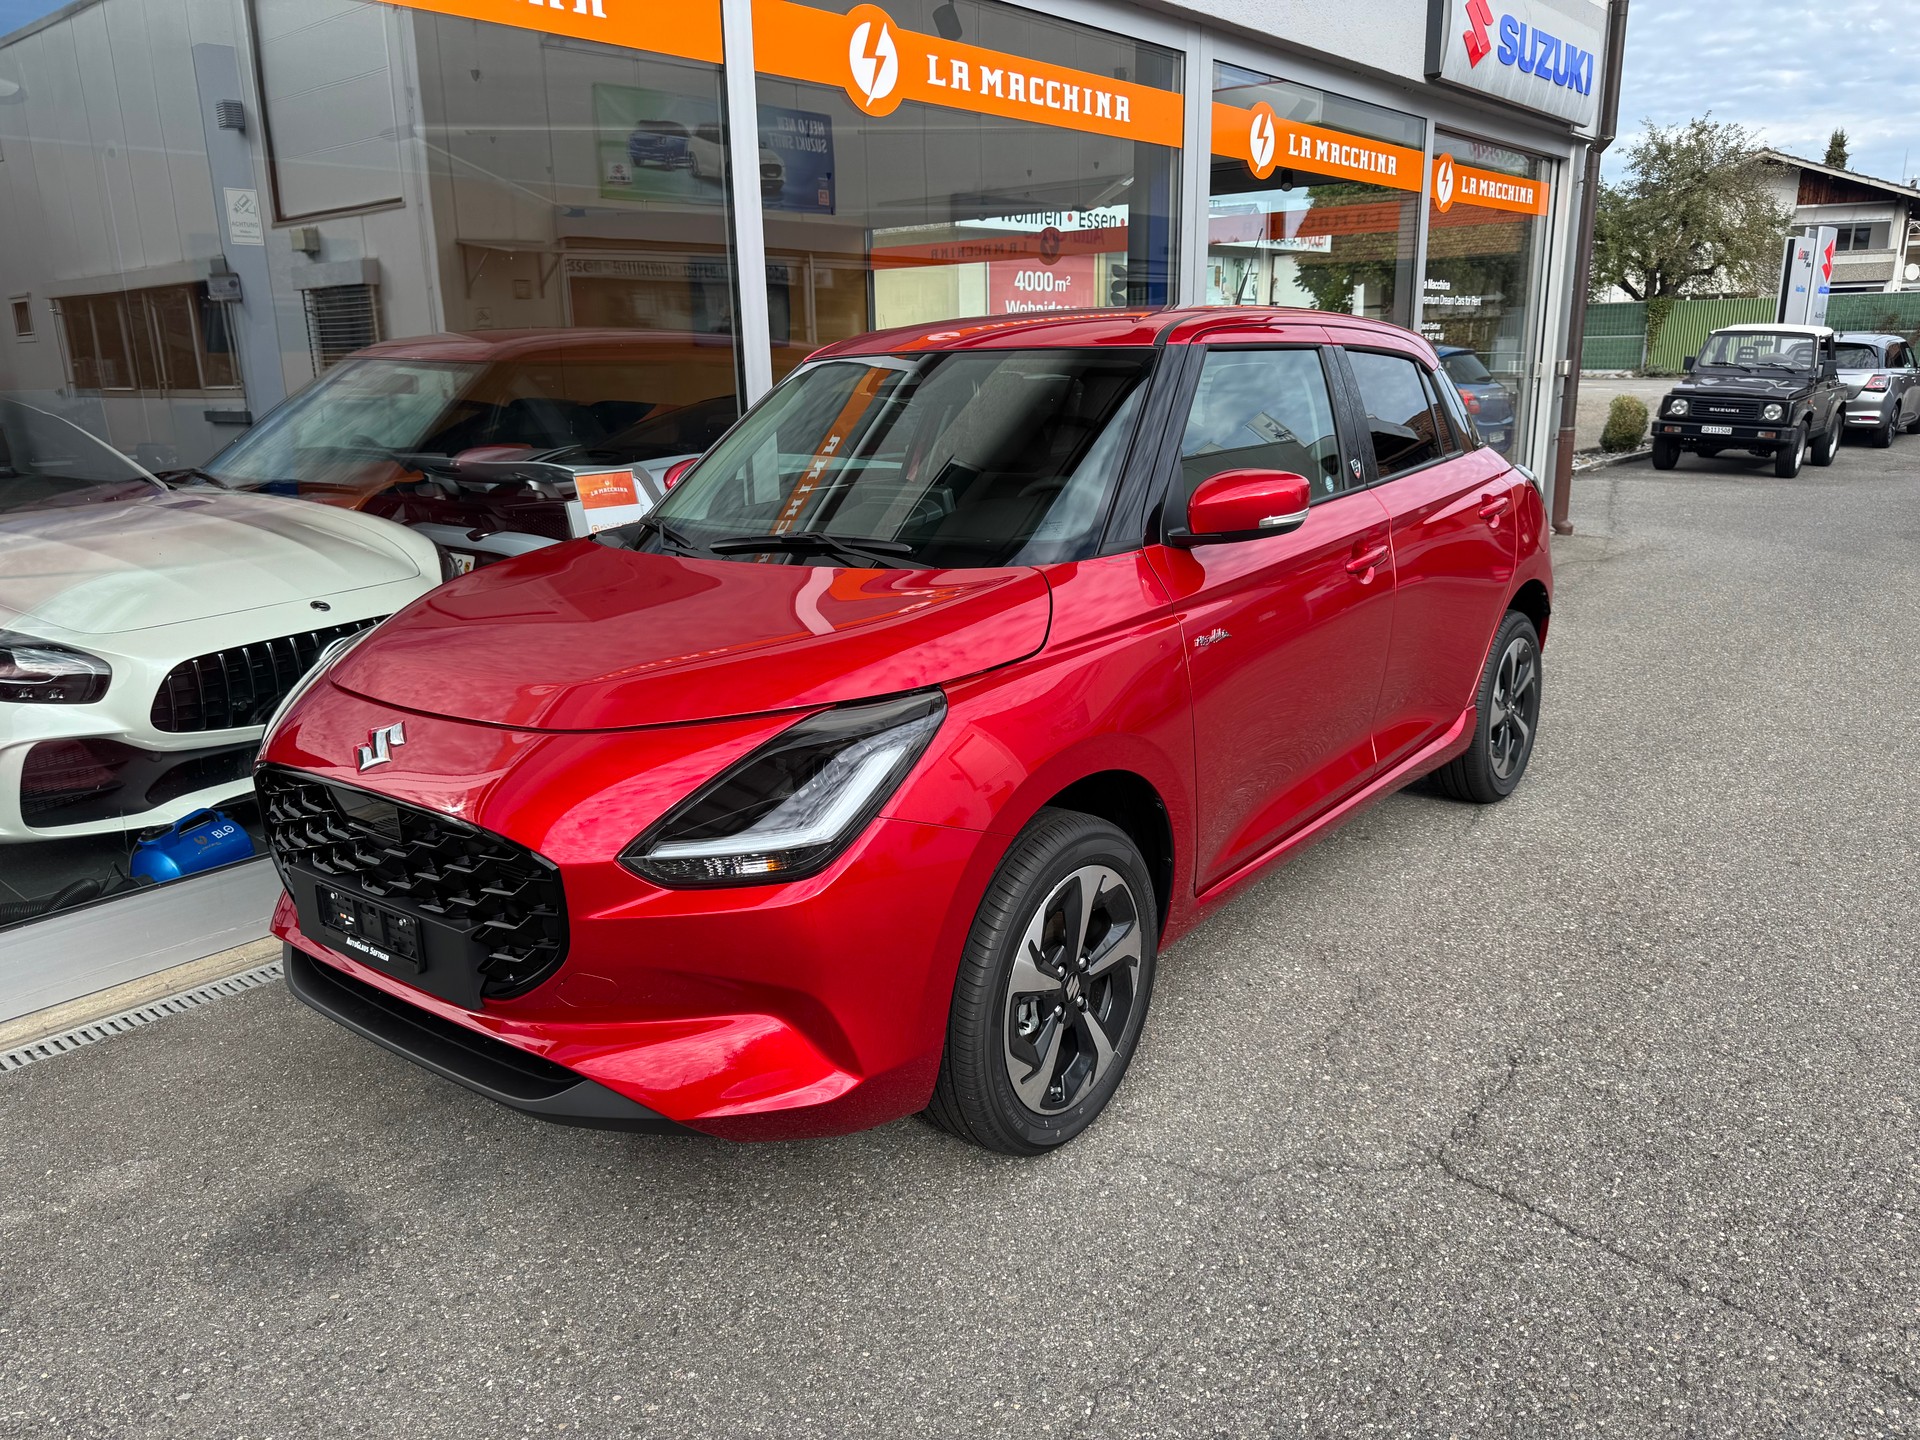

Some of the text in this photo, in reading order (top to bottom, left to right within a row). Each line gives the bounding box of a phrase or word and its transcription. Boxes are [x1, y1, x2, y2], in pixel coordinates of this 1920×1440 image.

[1497, 14, 1594, 96] SUZUKI
[926, 54, 1131, 123] LA MACCHINA
[1288, 133, 1397, 176] LA MACCHINA
[1461, 176, 1534, 205] LA MACCHINA
[1079, 212, 1117, 228] Essen
[1014, 270, 1054, 292] 4000
